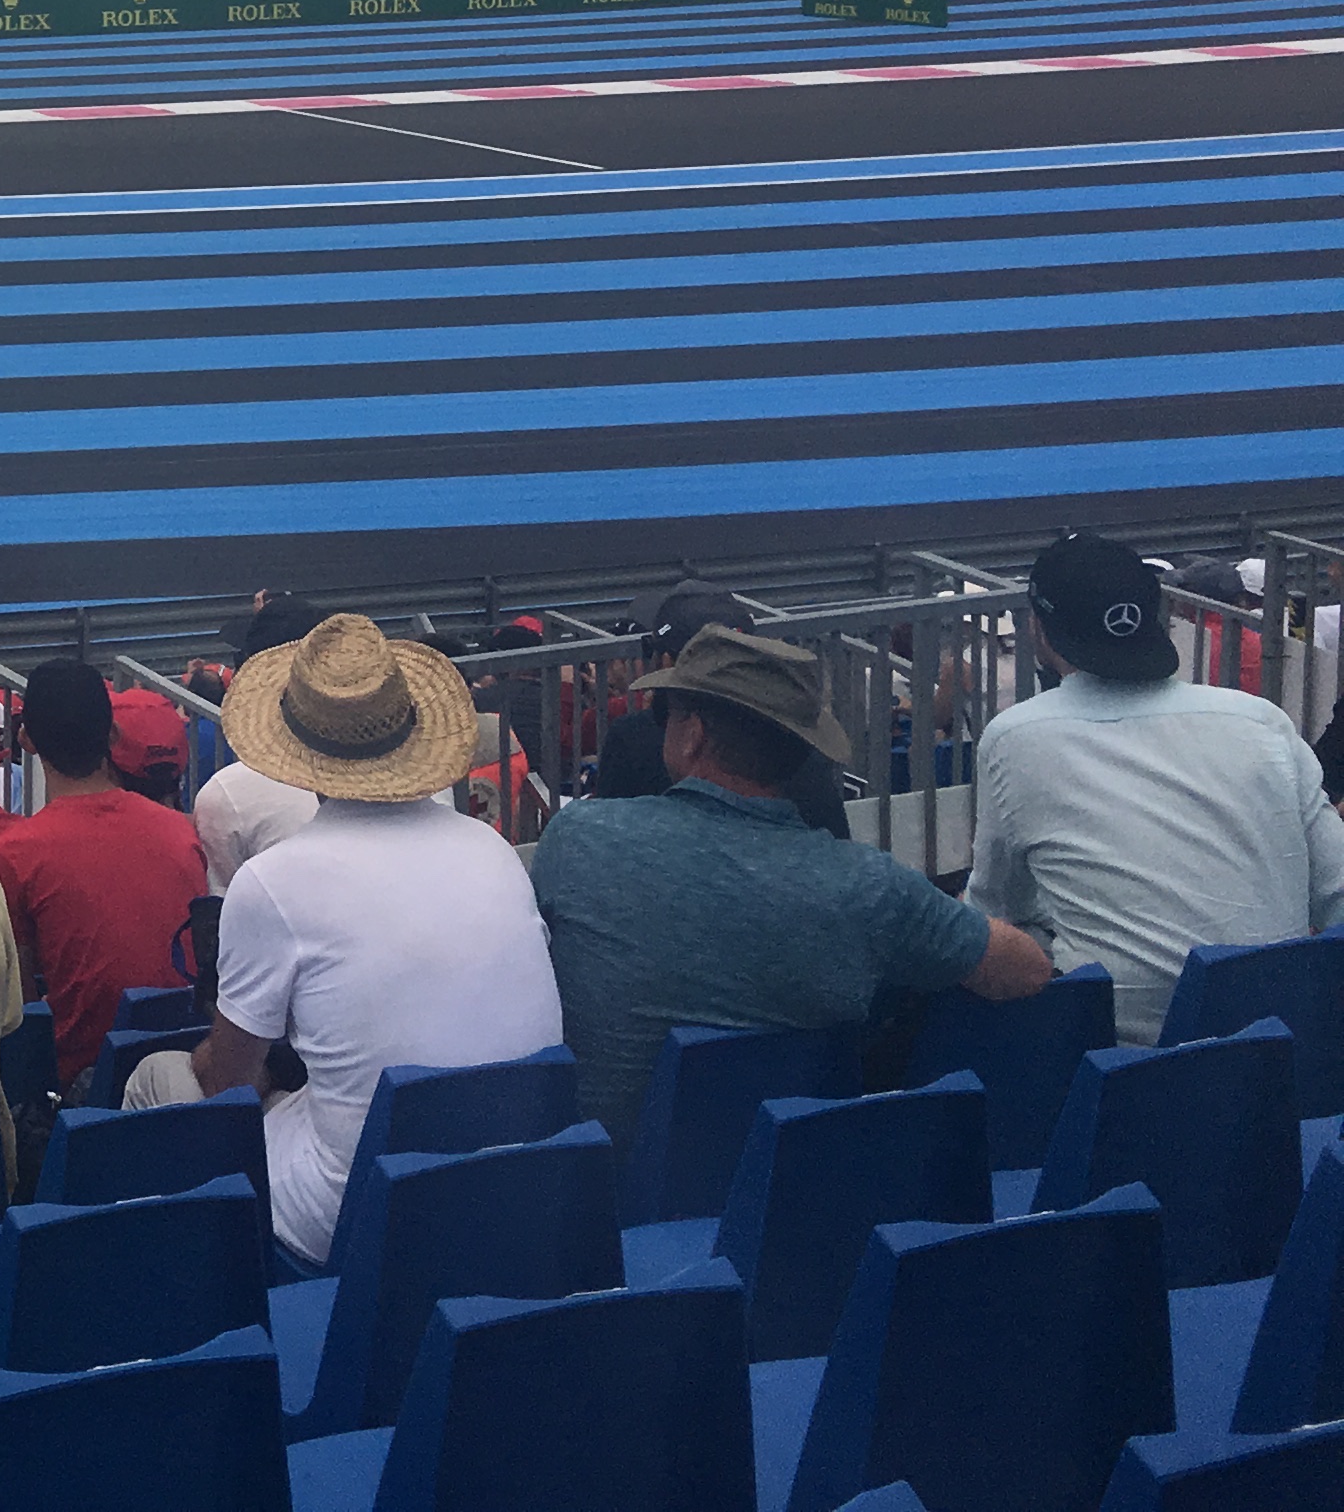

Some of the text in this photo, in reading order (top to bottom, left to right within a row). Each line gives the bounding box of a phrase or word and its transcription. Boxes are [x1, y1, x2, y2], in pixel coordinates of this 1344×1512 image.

[101, 8, 177, 27] ROLEX
[227, 3, 301, 22] ROLEX
[815, 3, 858, 17] ROLEX
[885, 8, 931, 23] ROLEX
